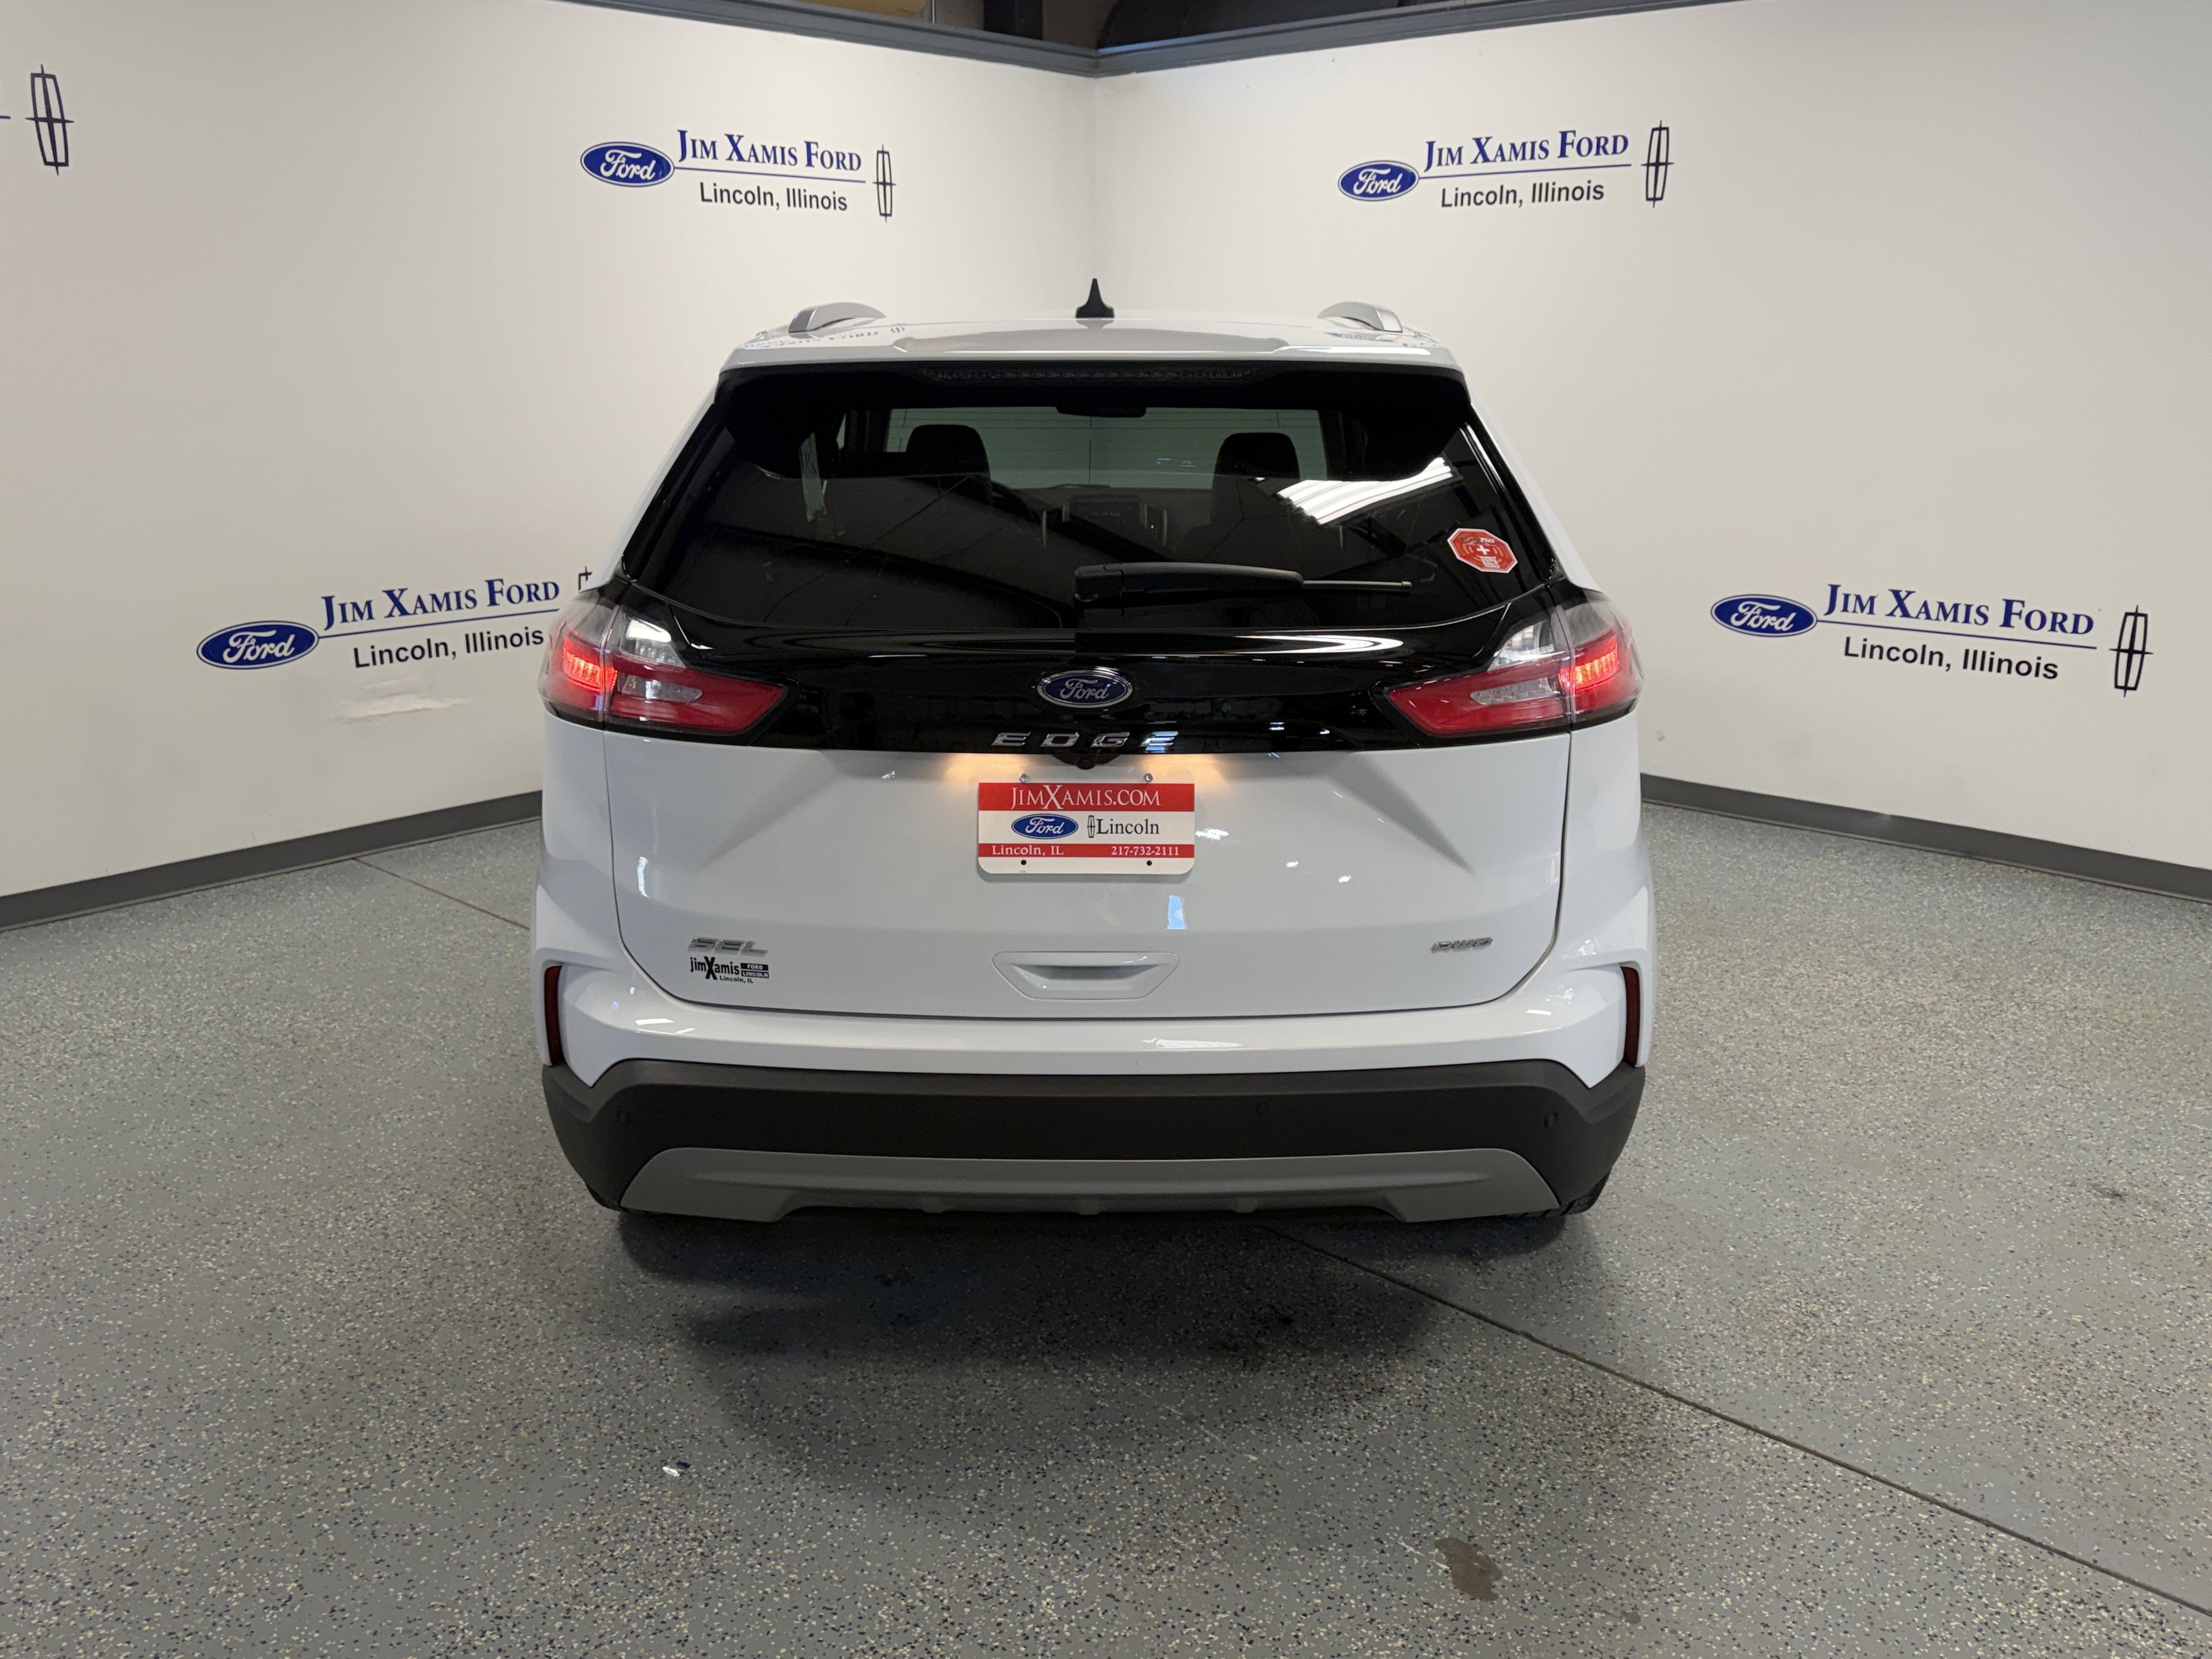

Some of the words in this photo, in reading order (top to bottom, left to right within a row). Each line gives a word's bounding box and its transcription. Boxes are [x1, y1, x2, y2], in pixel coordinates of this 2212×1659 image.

[678, 129, 718, 162] JIM
[725, 134, 797, 166] XAMIS
[804, 141, 861, 171] FORD
[1424, 141, 1463, 172] JIM
[1470, 137, 1549, 164] XAMIS
[1558, 130, 1628, 158] FORD
[600, 149, 656, 180] Ford
[1353, 169, 1401, 194] Ford
[1442, 185, 1522, 207] Lincoln,
[1532, 180, 1604, 202] Illinois
[700, 182, 779, 210] Lincoln,
[787, 188, 847, 211] Illinois
[321, 596, 375, 630] JIM
[382, 588, 477, 618] XAMIS
[485, 579, 559, 606] FORD
[1731, 601, 1795, 631] Ford
[1824, 584, 1876, 616] JIM
[1886, 589, 1988, 625] XAMIS
[2000, 599, 2093, 634] FORD
[223, 630, 295, 663] Ford
[354, 639, 456, 668] Lincoln,
[465, 627, 544, 653] Illinois
[1844, 637, 1950, 672] Lincoln,
[1963, 649, 2057, 679] Illinois
[1060, 678, 1111, 700] Ford
[991, 731, 1179, 748] EDGE
[1011, 785, 1161, 810] JIMXAMIS.COM
[1025, 817, 1064, 834] Ford
[1097, 819, 1160, 834] Lincoln
[992, 845, 1046, 856] Lincoln,
[1051, 845, 1064, 855] IL
[1111, 846, 1180, 856] 217-732-2111
[687, 937, 768, 956] SEL
[719, 975, 746, 983] Lincoln,
